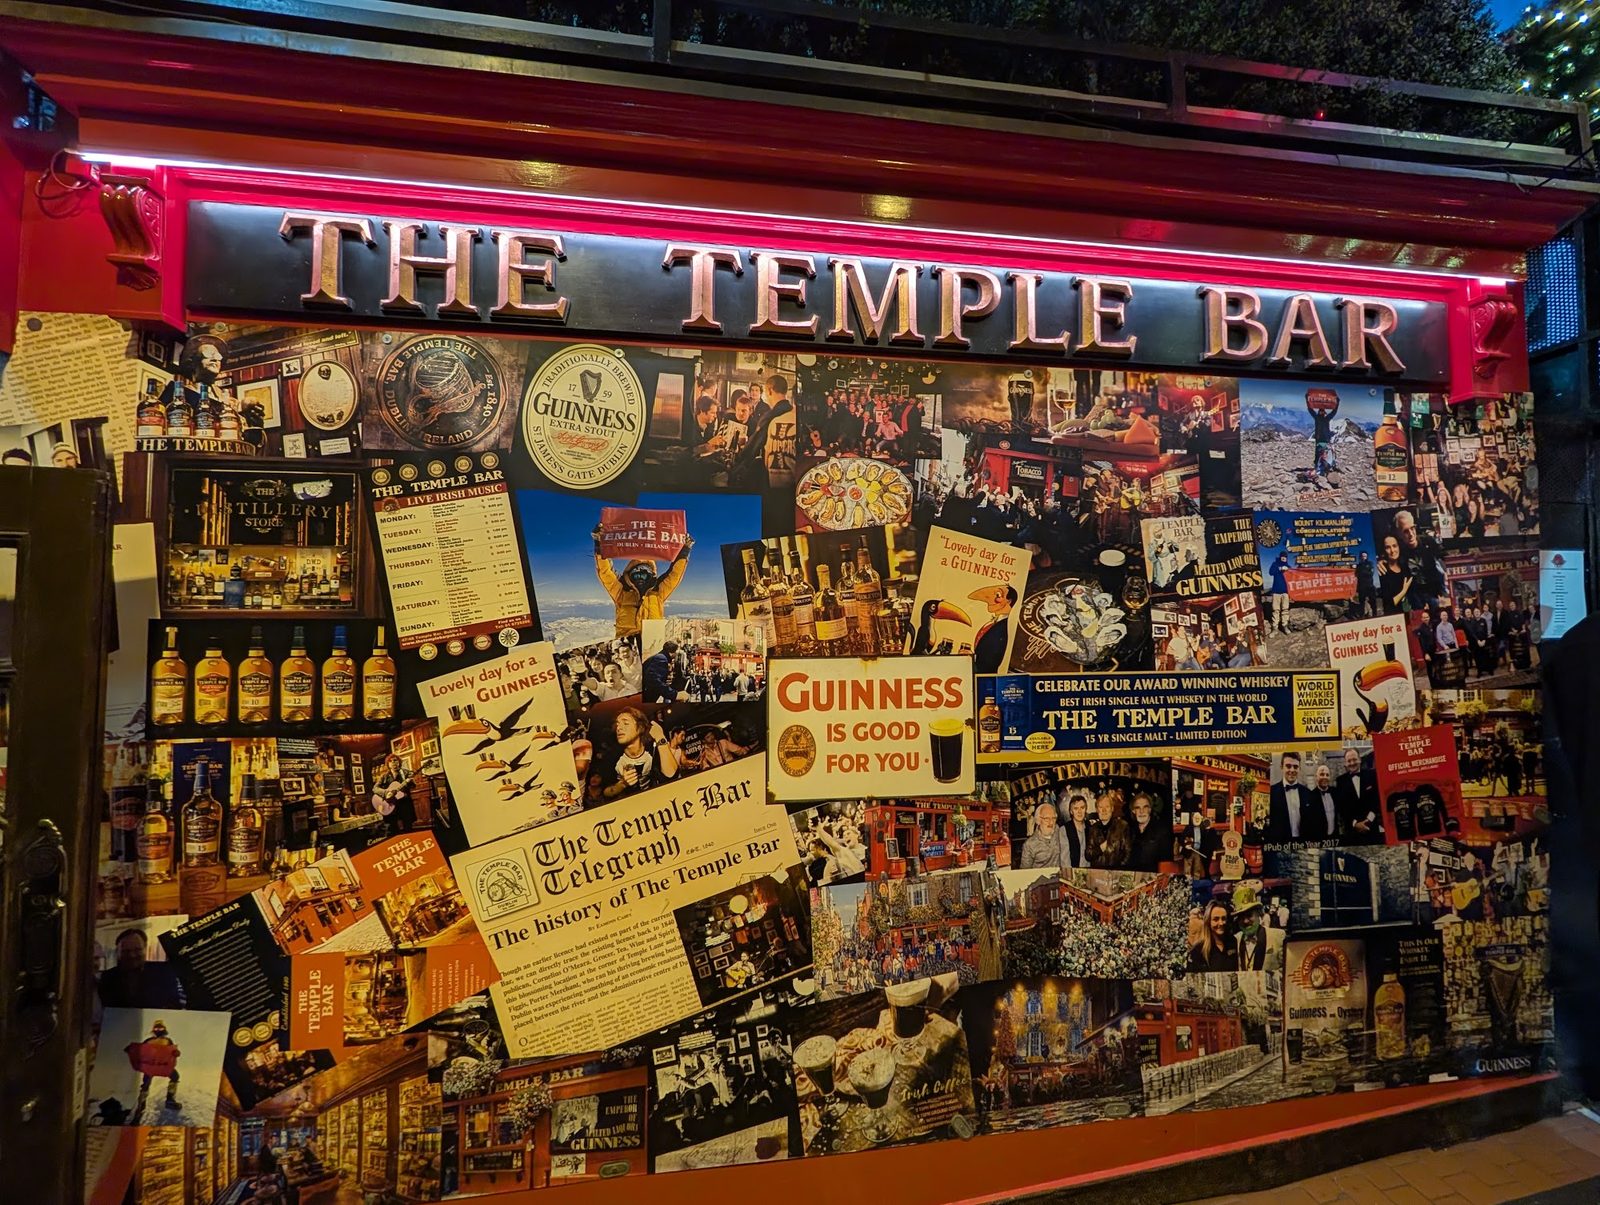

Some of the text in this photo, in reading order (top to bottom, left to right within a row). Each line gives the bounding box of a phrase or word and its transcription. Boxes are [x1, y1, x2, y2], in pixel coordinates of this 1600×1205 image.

[278, 211, 1406, 373] THE TEMPLE BAR
[402, 340, 451, 359] TEMPLE
[454, 341, 478, 360] THE
[542, 354, 635, 405] TRADITIONALLY BREWED
[568, 383, 612, 398] 17 59
[533, 391, 637, 432] GUINNESS
[549, 419, 616, 438] EXTRA STOUT
[172, 438, 231, 453] TEMPLE
[567, 469, 596, 480] GATE
[597, 443, 628, 475] DUBLIN
[255, 487, 275, 496] THE
[372, 470, 504, 498] THE TEMPLE BAR
[407, 484, 503, 506] LIVE IRISH MUSIC
[245, 517, 283, 527] STORE
[380, 513, 416, 524] MONDAY:
[631, 521, 656, 529] THE
[1234, 518, 1251, 530] THE
[383, 528, 422, 539] TUESDAY:
[1173, 527, 1194, 537] BAR
[1214, 530, 1253, 545] EMPEROR
[385, 541, 434, 554] WEDNESDAY:
[1244, 543, 1254, 553] OF
[388, 558, 433, 570] THURSDAY:
[941, 557, 948, 566] a
[980, 547, 998, 563] day
[1001, 553, 1016, 566] for
[1470, 562, 1513, 574] TEMPLE
[392, 580, 423, 590] FRIDAY:
[1176, 571, 1264, 596] GUINNESS
[396, 600, 440, 611] SATURDAY:
[400, 621, 435, 633] SUNDAY:
[1331, 624, 1402, 643] Lovely day for a
[1333, 643, 1379, 659] GUINNESS
[430, 656, 538, 698] Lovely day for a
[1035, 680, 1101, 693] CELEBRATE
[1103, 679, 1132, 691] OUR
[1134, 678, 1179, 690] AWARD
[1181, 677, 1238, 689] WINNING
[1240, 676, 1290, 688] WHISKEY
[476, 669, 556, 703] GUINNESS
[777, 672, 964, 712] GUINNESS
[1296, 681, 1334, 691] WORLD
[1060, 693, 1268, 707] BEST IRISH SINGLE MALT WHISKEY IN THE WORLD
[1297, 698, 1335, 707] AWARDS
[1043, 705, 1277, 731] THE TEMPLE BAR
[1302, 717, 1331, 725] SINGLE
[827, 721, 920, 743] IS GOOD
[1085, 729, 1247, 743] 15 YR SINGLE MALT LIMITED EDITION
[1306, 725, 1329, 733] MALT
[1398, 738, 1431, 751] TEMPLE
[1408, 734, 1420, 742] THE
[1407, 747, 1424, 756] BAR
[827, 752, 920, 773] FOR YOU
[1200, 756, 1246, 775] TEMPLE
[1388, 762, 1411, 772] OFFICIAL
[1411, 755, 1447, 767] MERCHANDISE
[1011, 770, 1048, 797] THE
[1052, 760, 1132, 782] TEMPLE
[532, 777, 752, 867] The Temple Bar
[388, 838, 412, 854] THE
[1264, 839, 1340, 851] #Pub of the Year 2017
[373, 837, 435, 874] TEMPLE
[540, 830, 682, 896] Telegraph
[392, 855, 427, 878] BAR
[482, 861, 510, 876] TEMPLE
[511, 865, 523, 880] BAR
[489, 837, 781, 951] The history of The Temple Bar
[171, 902, 240, 938] THE TEMPLE BAR
[299, 988, 308, 1014] THE
[308, 969, 321, 1034] TEMPLE
[321, 983, 334, 1017] BAR
[1289, 1006, 1328, 1019] Guinness
[1476, 1057, 1532, 1073] GUINNESS
[549, 1066, 584, 1083] BAR
[570, 1135, 641, 1150] GUINNESS
